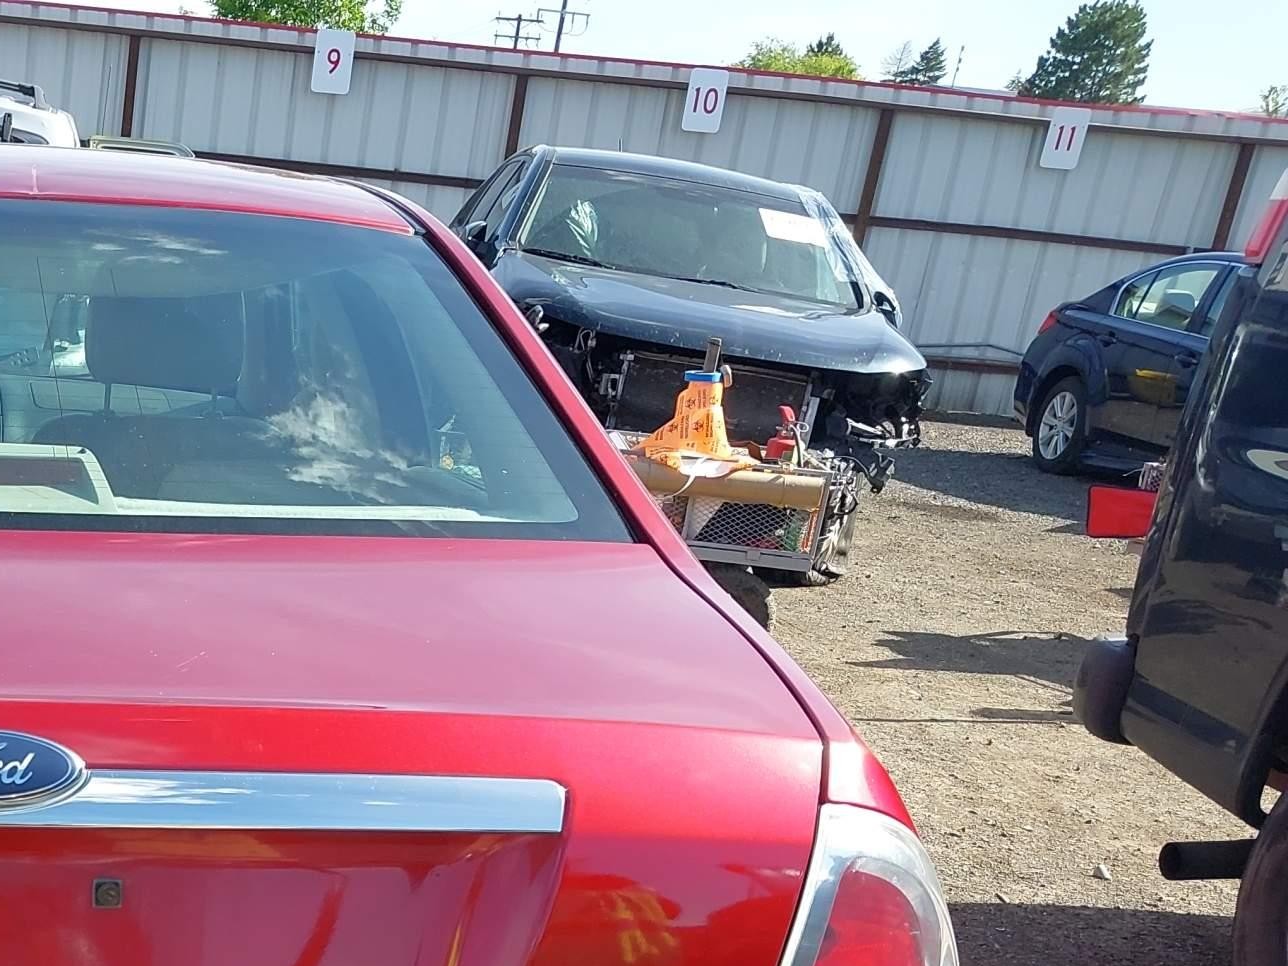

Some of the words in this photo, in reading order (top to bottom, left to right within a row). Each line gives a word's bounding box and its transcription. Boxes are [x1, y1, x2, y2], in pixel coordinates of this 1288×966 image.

[327, 48, 341, 75] 9
[692, 86, 719, 115] 10
[1054, 124, 1077, 152] 11
